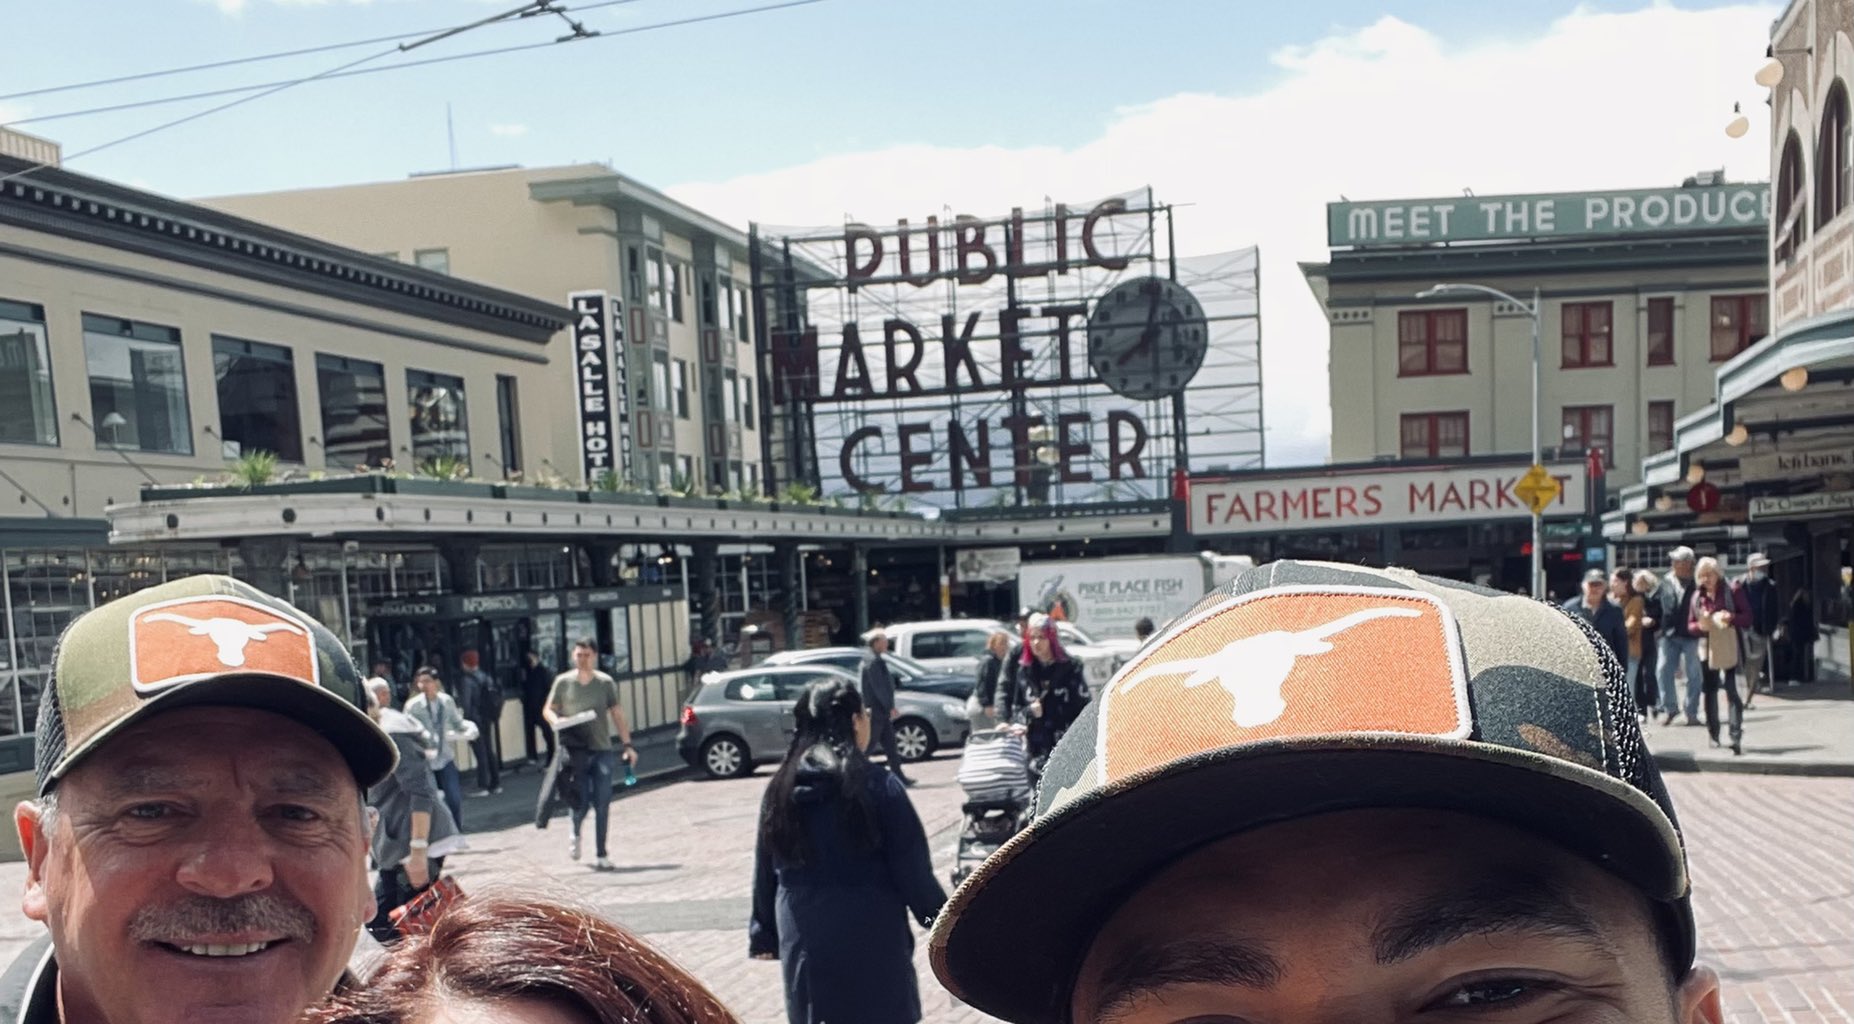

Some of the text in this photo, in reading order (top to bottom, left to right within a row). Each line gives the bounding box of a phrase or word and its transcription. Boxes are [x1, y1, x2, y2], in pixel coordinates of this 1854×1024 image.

[844, 197, 1128, 293] PUBLIC
[1348, 204, 1455, 240] MEET
[1479, 200, 1556, 234] THE
[579, 334, 606, 413] SALLE
[771, 302, 1088, 405] MARKET
[839, 410, 1147, 492] CENTER
[1206, 475, 1572, 525] FARMERS MARKT
[1078, 577, 1183, 595] PIKE PLACE FISH
